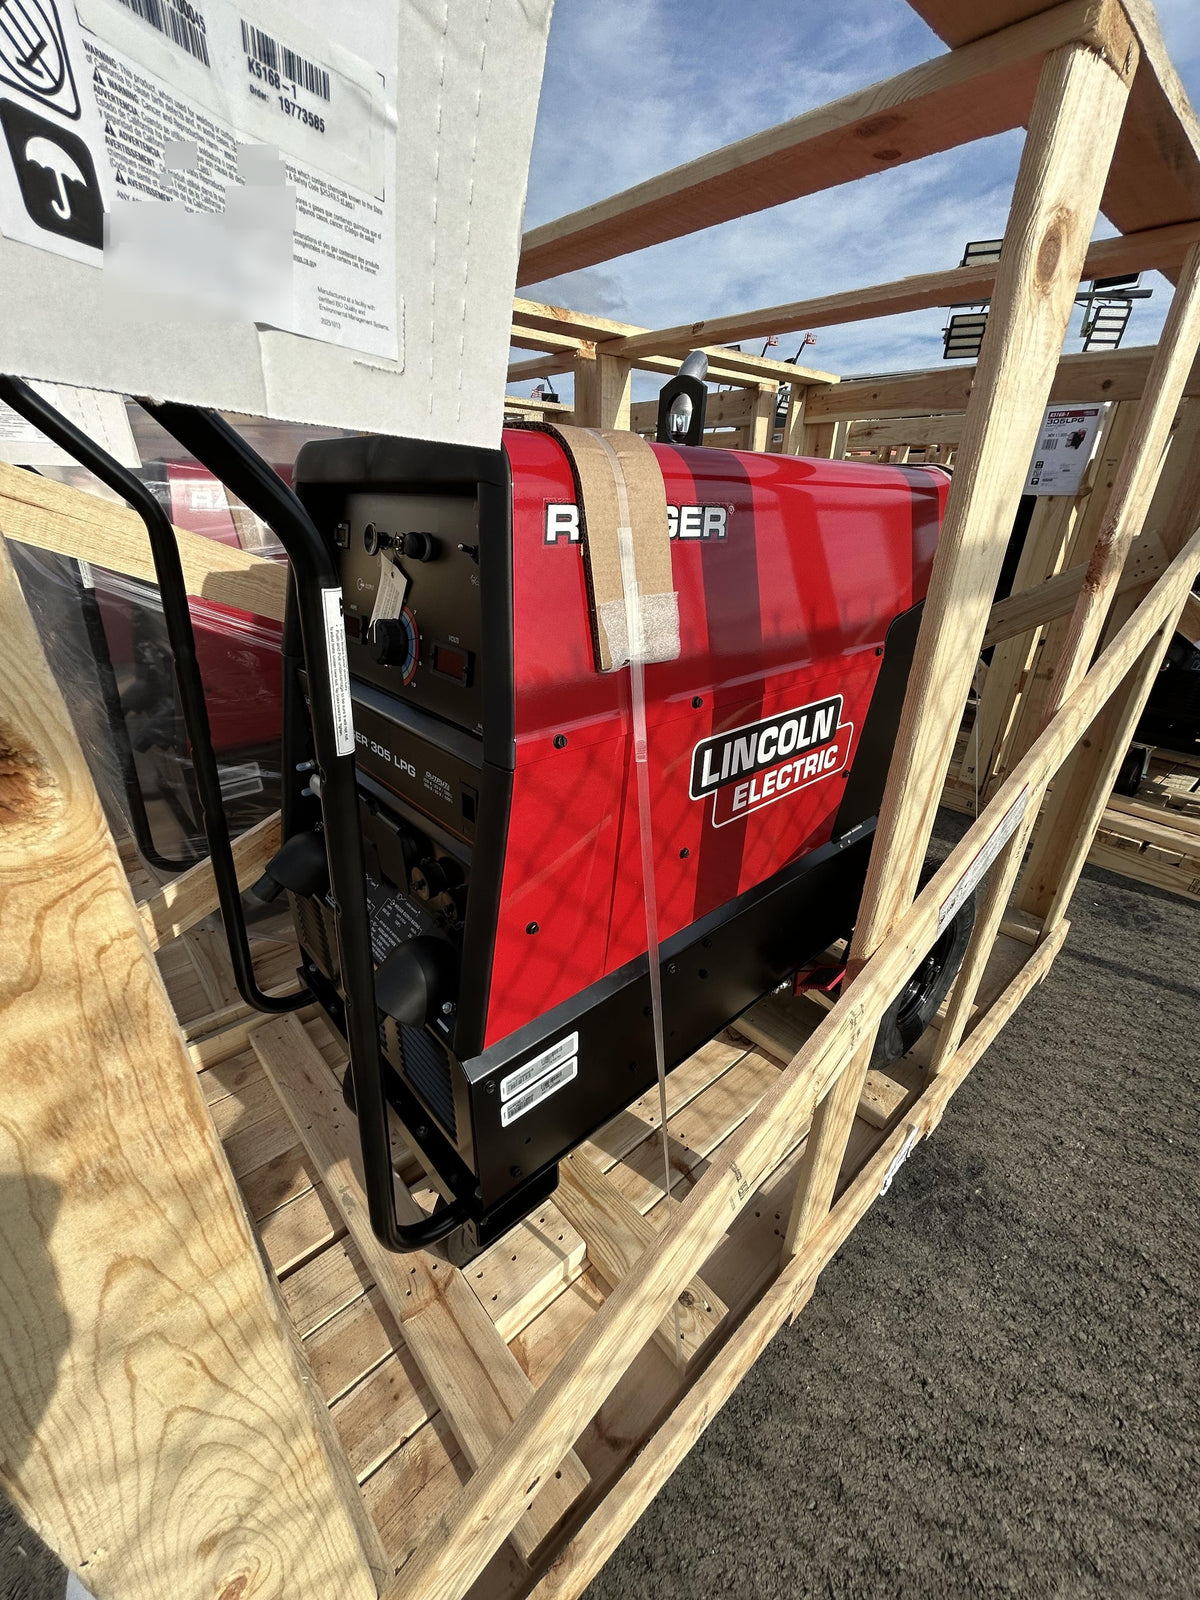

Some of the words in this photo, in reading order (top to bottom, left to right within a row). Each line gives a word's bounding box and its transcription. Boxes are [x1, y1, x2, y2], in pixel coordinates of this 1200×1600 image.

[82, 39, 117, 69] WARNING:
[119, 63, 132, 78] This
[158, 89, 172, 104] when
[173, 99, 186, 112] used
[195, 113, 213, 130] welding
[92, 82, 140, 117] ADVERTENCIA:
[141, 111, 162, 130] Cuando
[93, 57, 124, 83] California
[132, 83, 149, 99] cause
[151, 93, 163, 107] birth
[165, 103, 184, 120] defects
[202, 126, 214, 139] some
[103, 108, 133, 134] seguridad
[106, 76, 139, 104] WARNING:
[141, 98, 160, 116] Cancer
[162, 111, 172, 123] and
[173, 117, 204, 144] Reproductive
[250, 84, 270, 103] Order:
[279, 96, 325, 134] 19773585
[95, 95, 117, 114] Estado
[127, 113, 153, 135] California
[214, 163, 228, 176] causa
[106, 145, 137, 168] chimiques
[293, 174, 306, 188] Safety
[308, 181, 318, 193] Code
[298, 169, 309, 180] which
[311, 176, 326, 188] contain
[327, 183, 347, 199] chemicals
[318, 286, 346, 301] Manufactured
[319, 303, 347, 318] Environmental
[348, 313, 372, 325] Management
[344, 304, 357, 314] Quality
[371, 740, 391, 763] 305
[394, 755, 416, 778] LPG
[701, 705, 835, 788] LINCOLN
[732, 745, 839, 812] ELECTRIC
